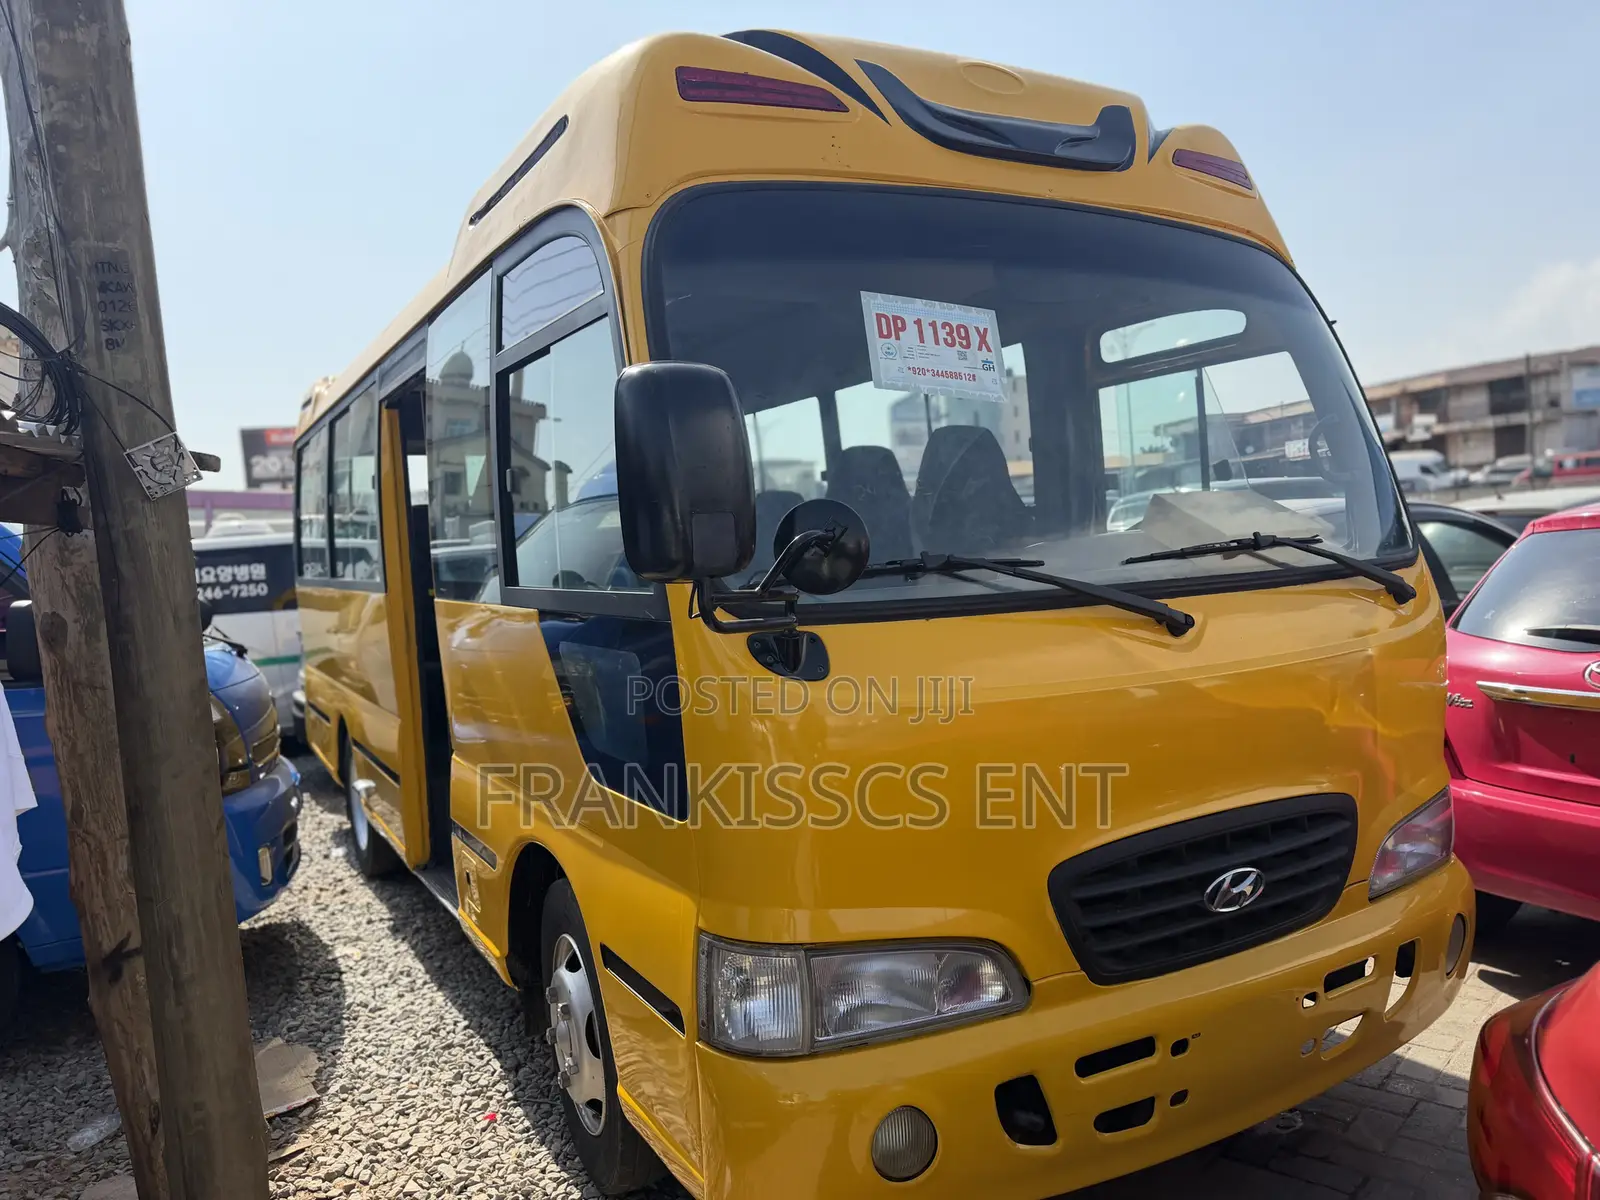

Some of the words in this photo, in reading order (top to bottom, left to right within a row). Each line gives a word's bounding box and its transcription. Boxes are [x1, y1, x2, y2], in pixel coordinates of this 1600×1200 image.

[875, 312, 907, 341] DP
[913, 317, 972, 350] 1139
[973, 325, 993, 353] X
[982, 363, 996, 372] GH
